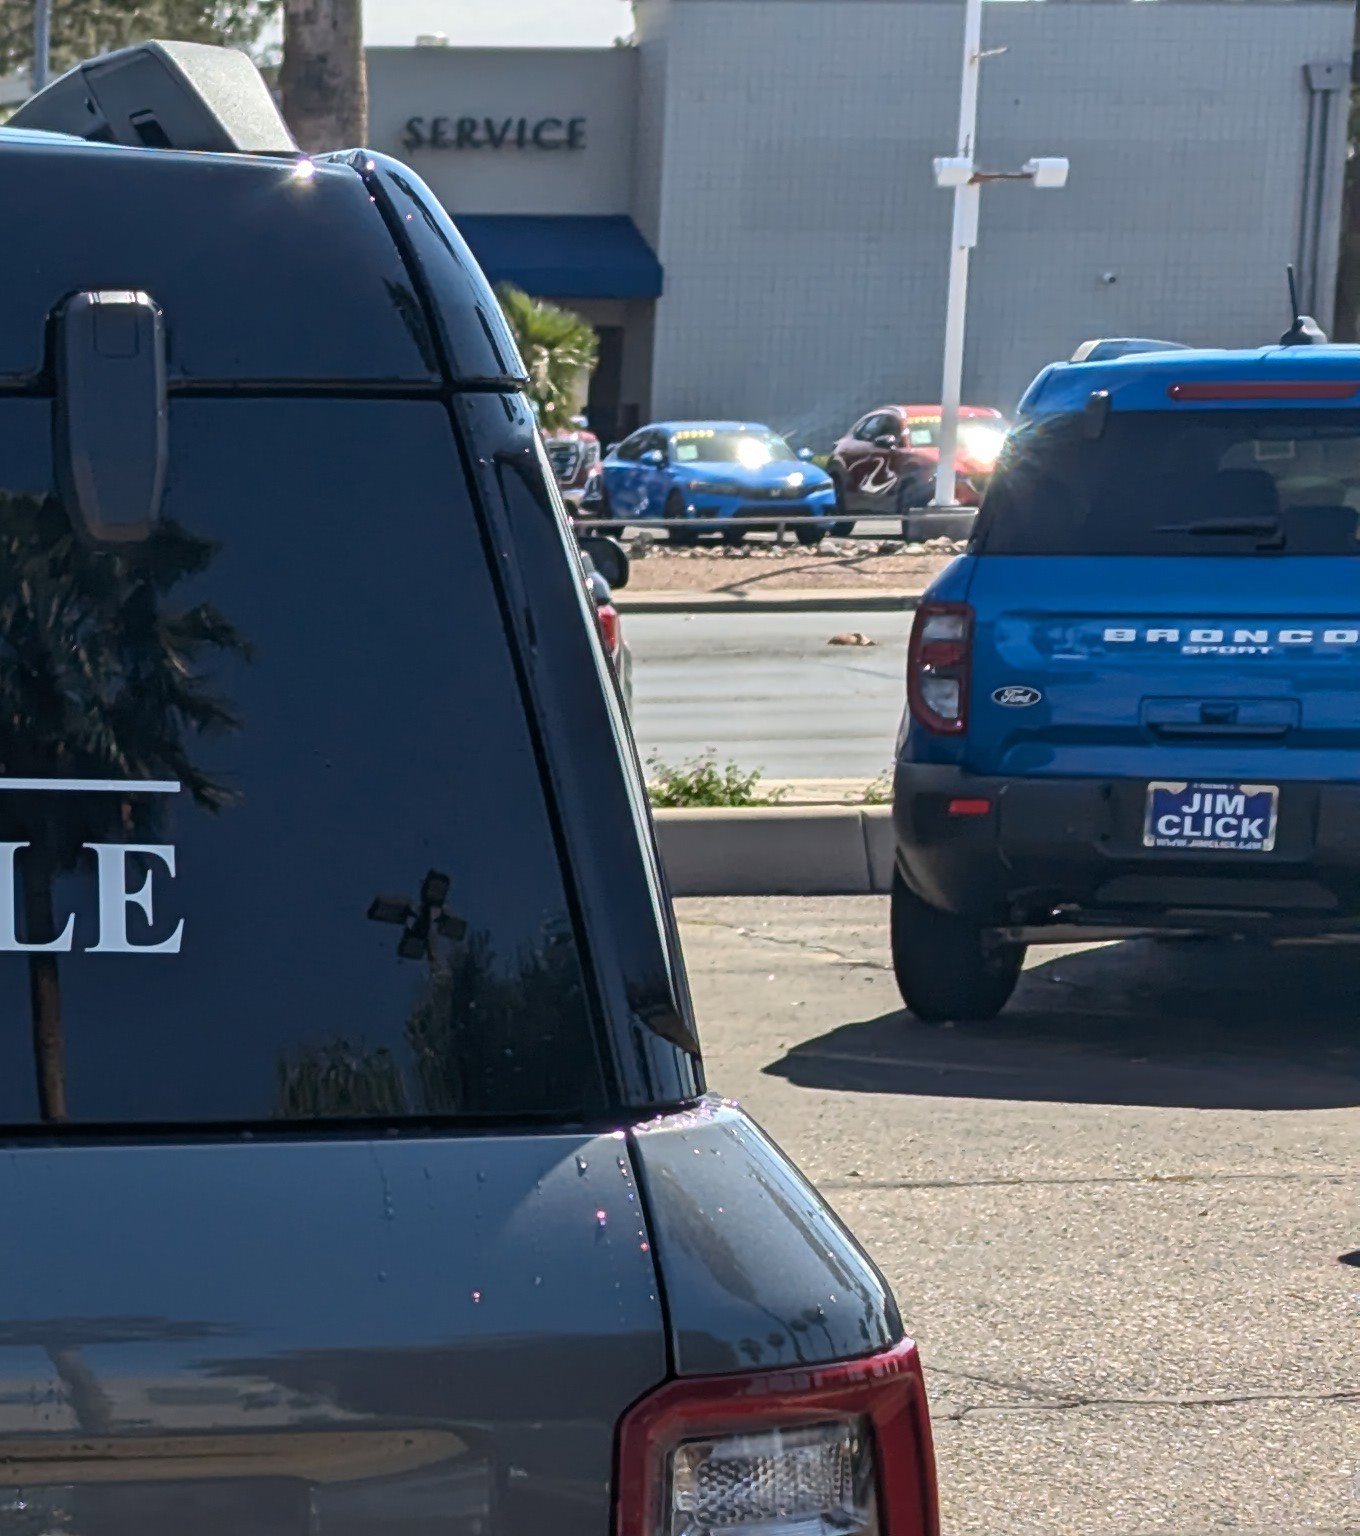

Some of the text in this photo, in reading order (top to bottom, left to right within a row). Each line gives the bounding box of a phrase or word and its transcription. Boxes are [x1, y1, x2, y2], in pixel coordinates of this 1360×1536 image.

[403, 116, 588, 151] SERVICE
[1103, 628, 1359, 644] BRONCO
[1181, 792, 1246, 815] JIM
[1157, 814, 1264, 839] CLICK
